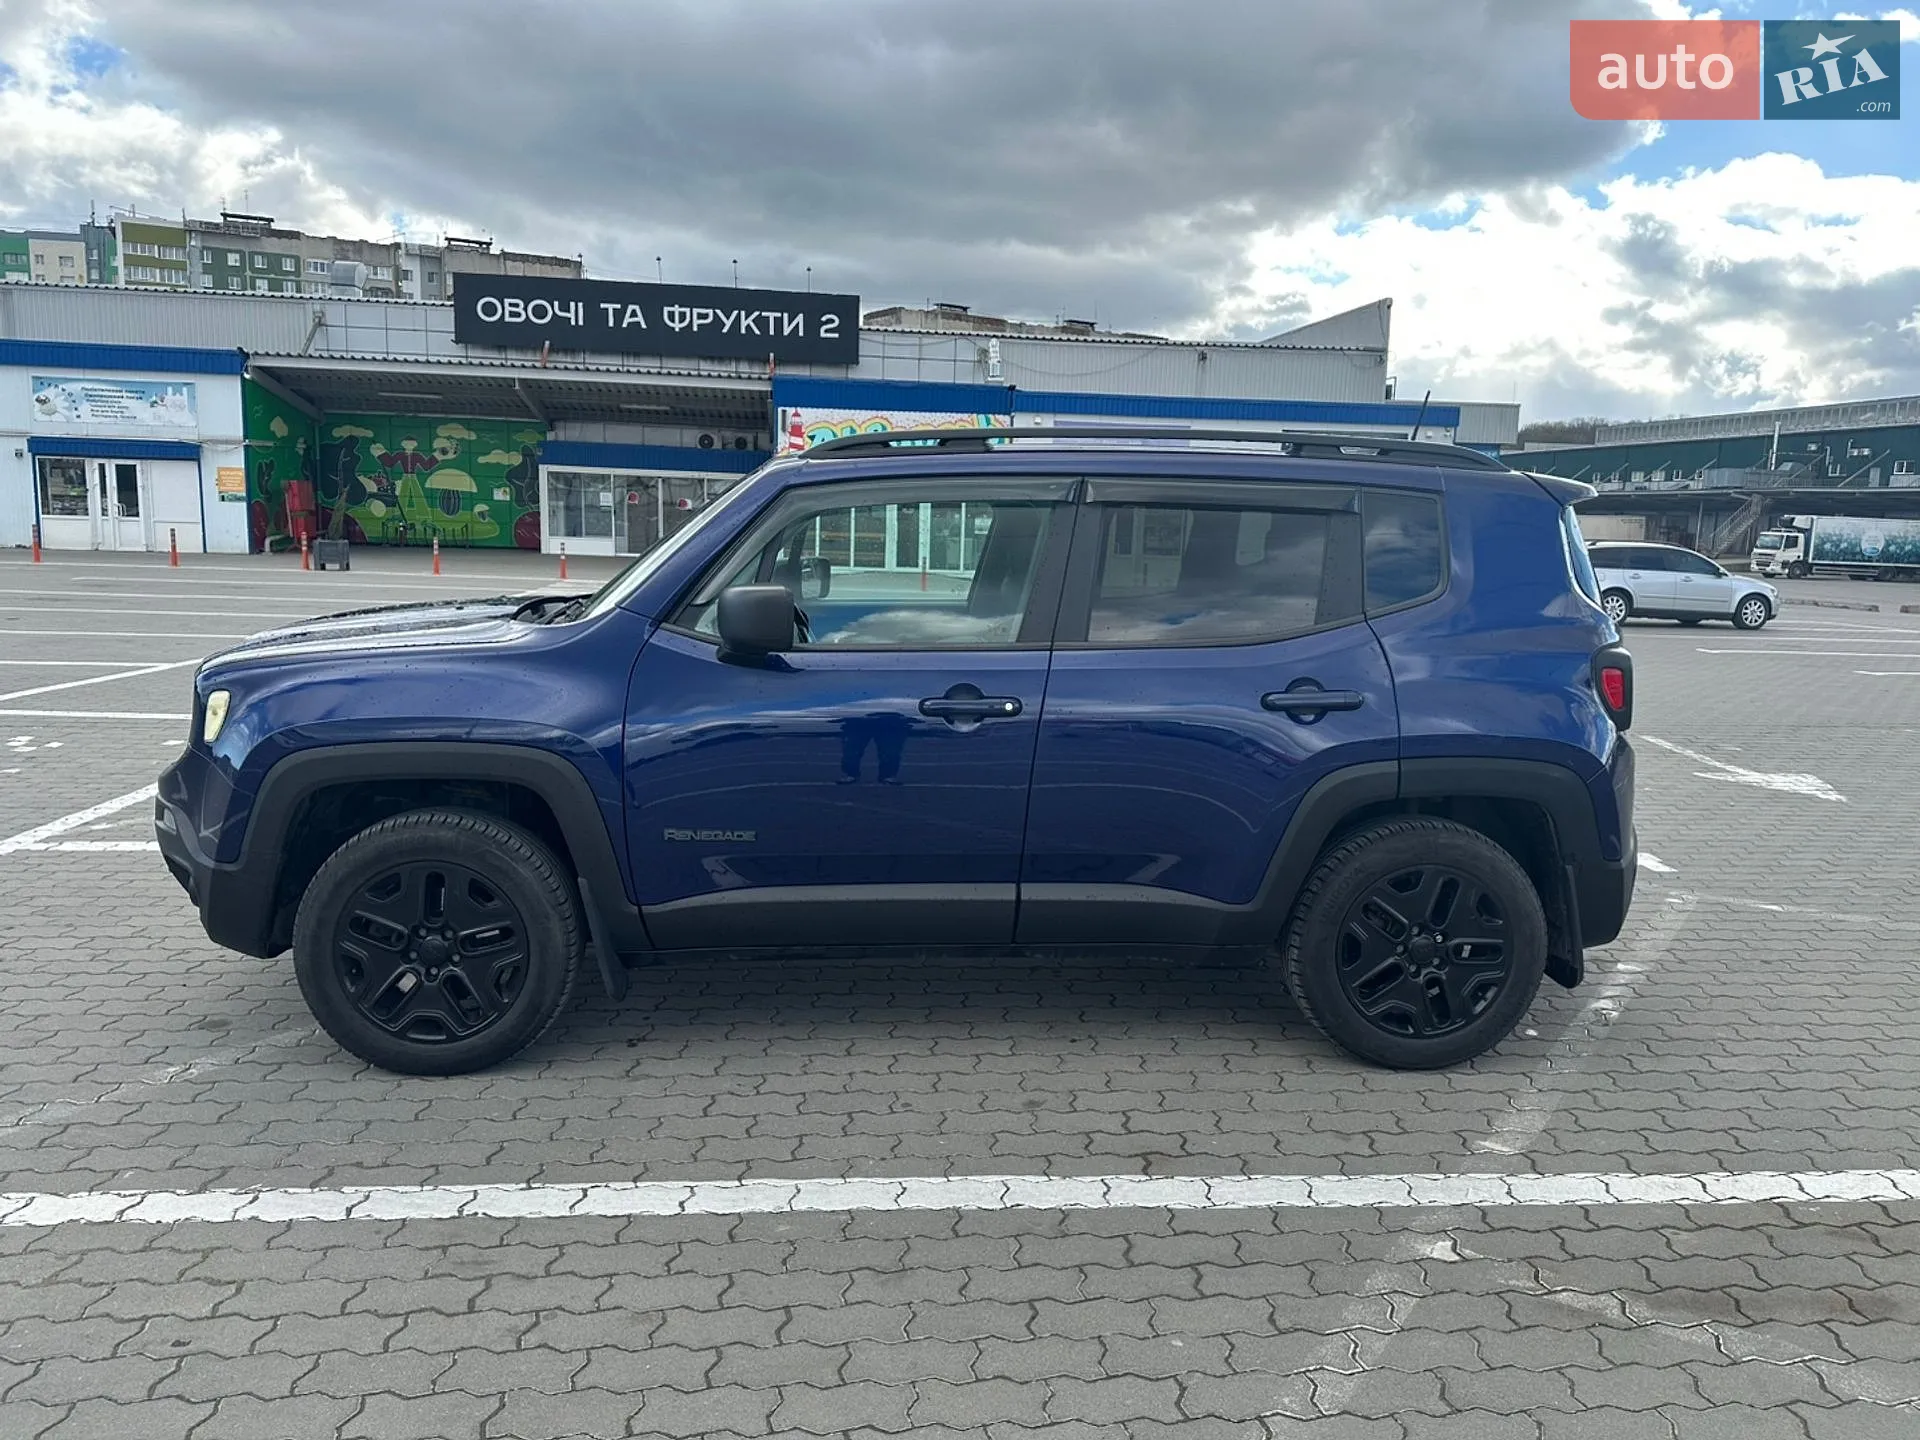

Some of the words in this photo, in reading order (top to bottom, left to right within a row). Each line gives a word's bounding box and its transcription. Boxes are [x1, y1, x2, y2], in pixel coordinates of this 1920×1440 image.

[475, 296, 584, 327] ОВОЧІ
[600, 302, 648, 329] ТА
[662, 304, 805, 337] ФРУКТИ
[819, 313, 840, 339] 2
[663, 828, 756, 841] RENEGADE
